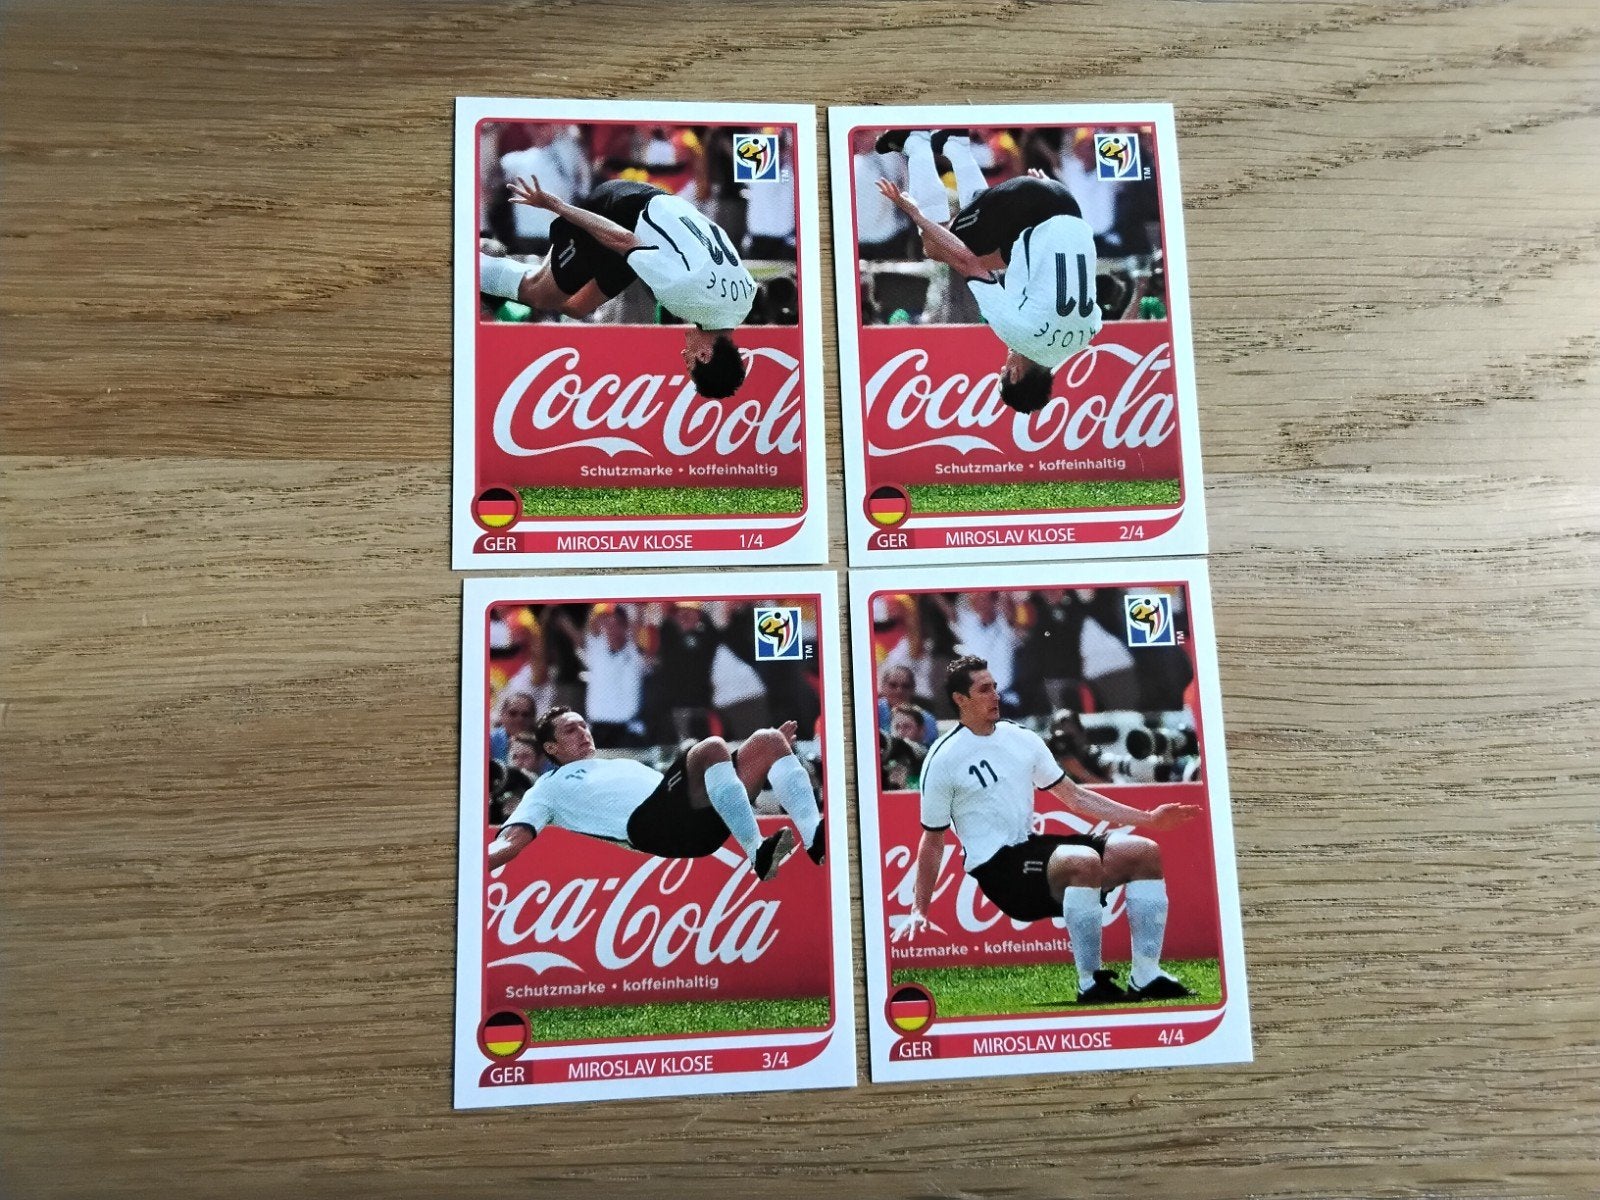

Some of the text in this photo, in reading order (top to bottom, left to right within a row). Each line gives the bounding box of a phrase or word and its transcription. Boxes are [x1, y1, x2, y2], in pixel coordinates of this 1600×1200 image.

[1142, 166, 1151, 181] TM
[1055, 252, 1094, 318] 11
[580, 464, 778, 477] Schutzmarke koffeinhaltig
[935, 457, 1127, 475] Schutzmarke koffeinhaltig
[483, 533, 764, 551] GER MIROSLAV KLOSE 1/4
[876, 525, 1145, 548] GER MIROSLAV KLOSE 2/4
[1176, 630, 1185, 646] TM
[805, 644, 814, 660] TM
[968, 759, 998, 788] 11
[505, 975, 719, 999] Schutzmarke koffeinhaltig
[899, 1029, 1185, 1058] GER MIROSLAV KLOSE 4/4
[489, 1051, 789, 1084] GER MIROSLAV KLOSE 3/4
